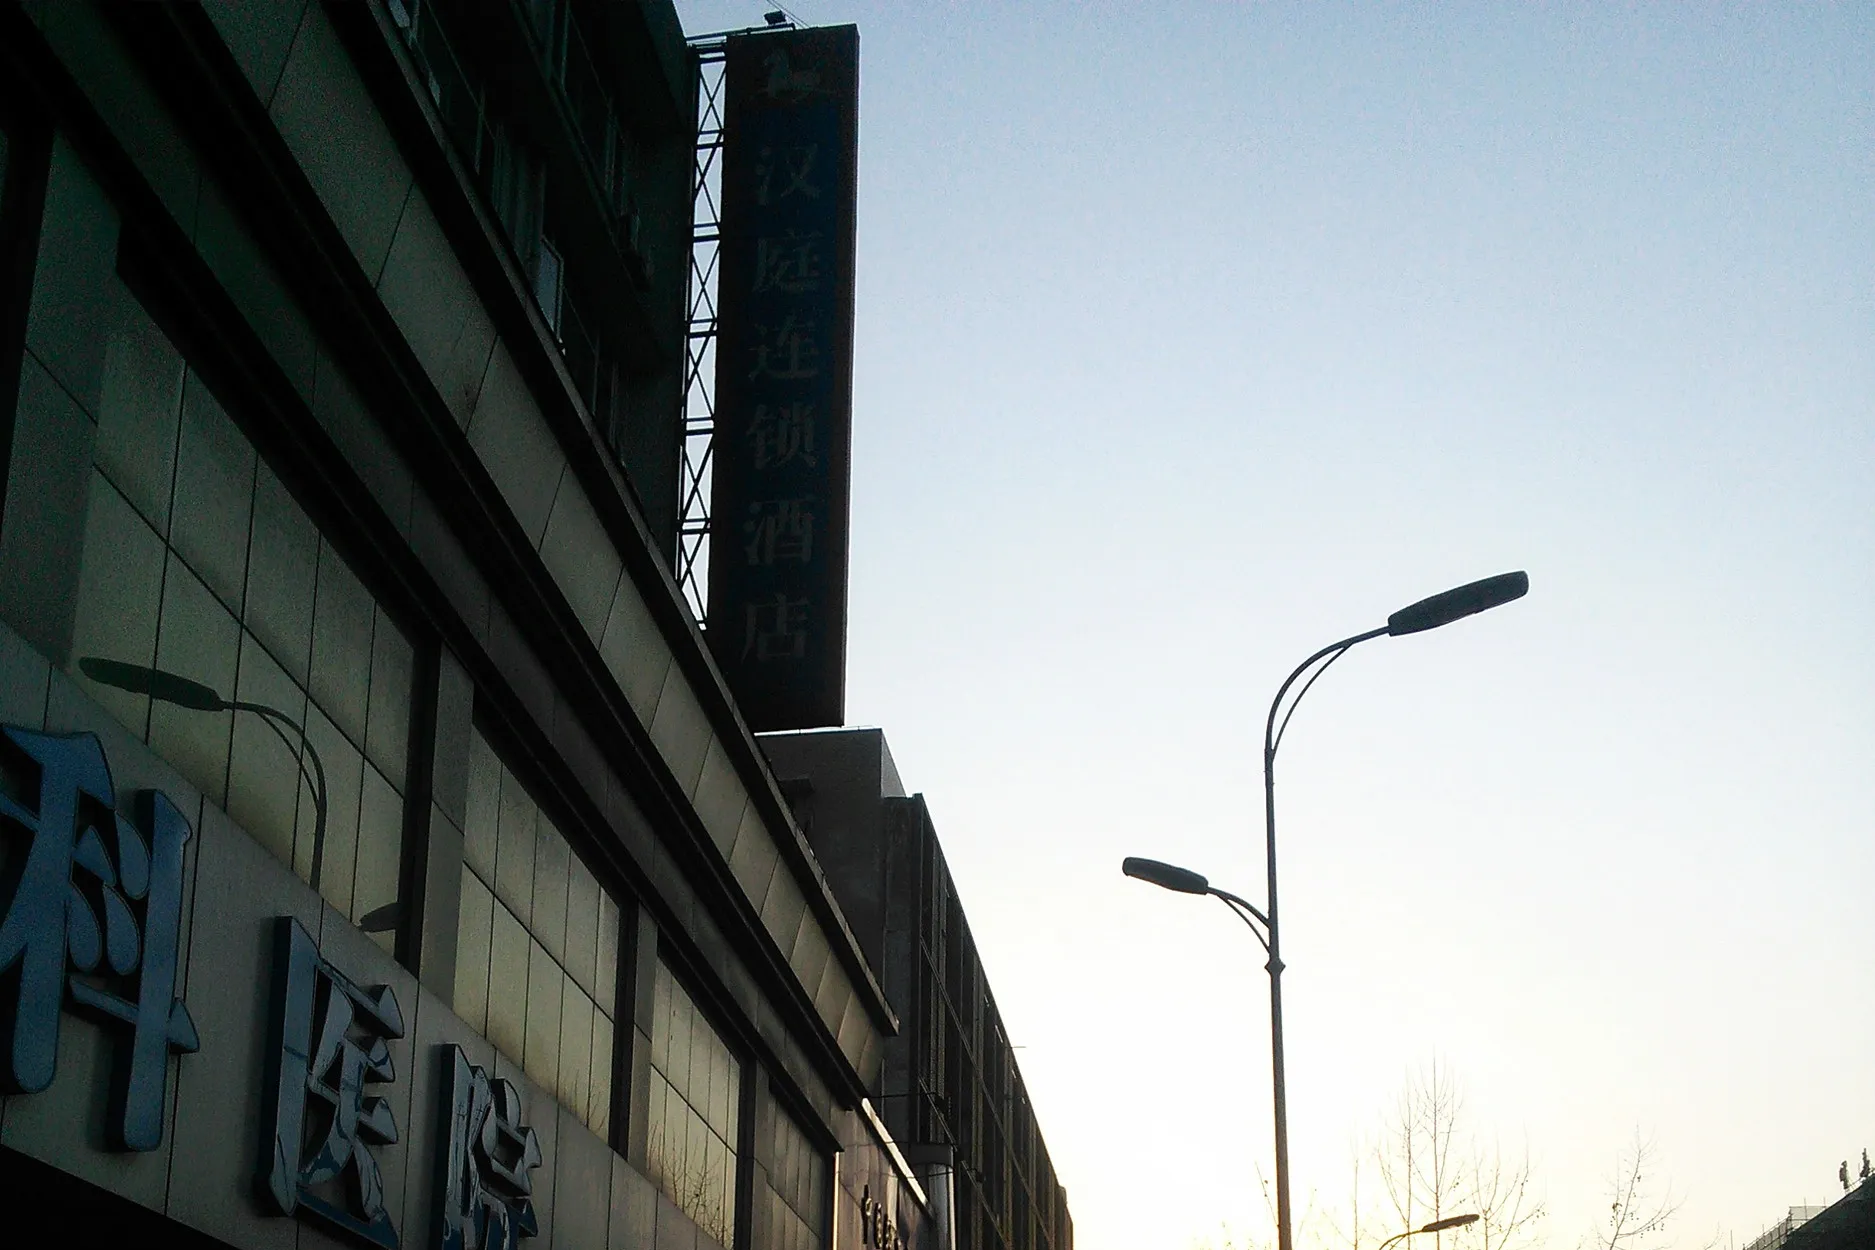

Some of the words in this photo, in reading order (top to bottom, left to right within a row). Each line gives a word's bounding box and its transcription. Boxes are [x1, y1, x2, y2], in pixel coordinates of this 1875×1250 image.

[742, 140, 822, 663] 汉庭连锁酒店
